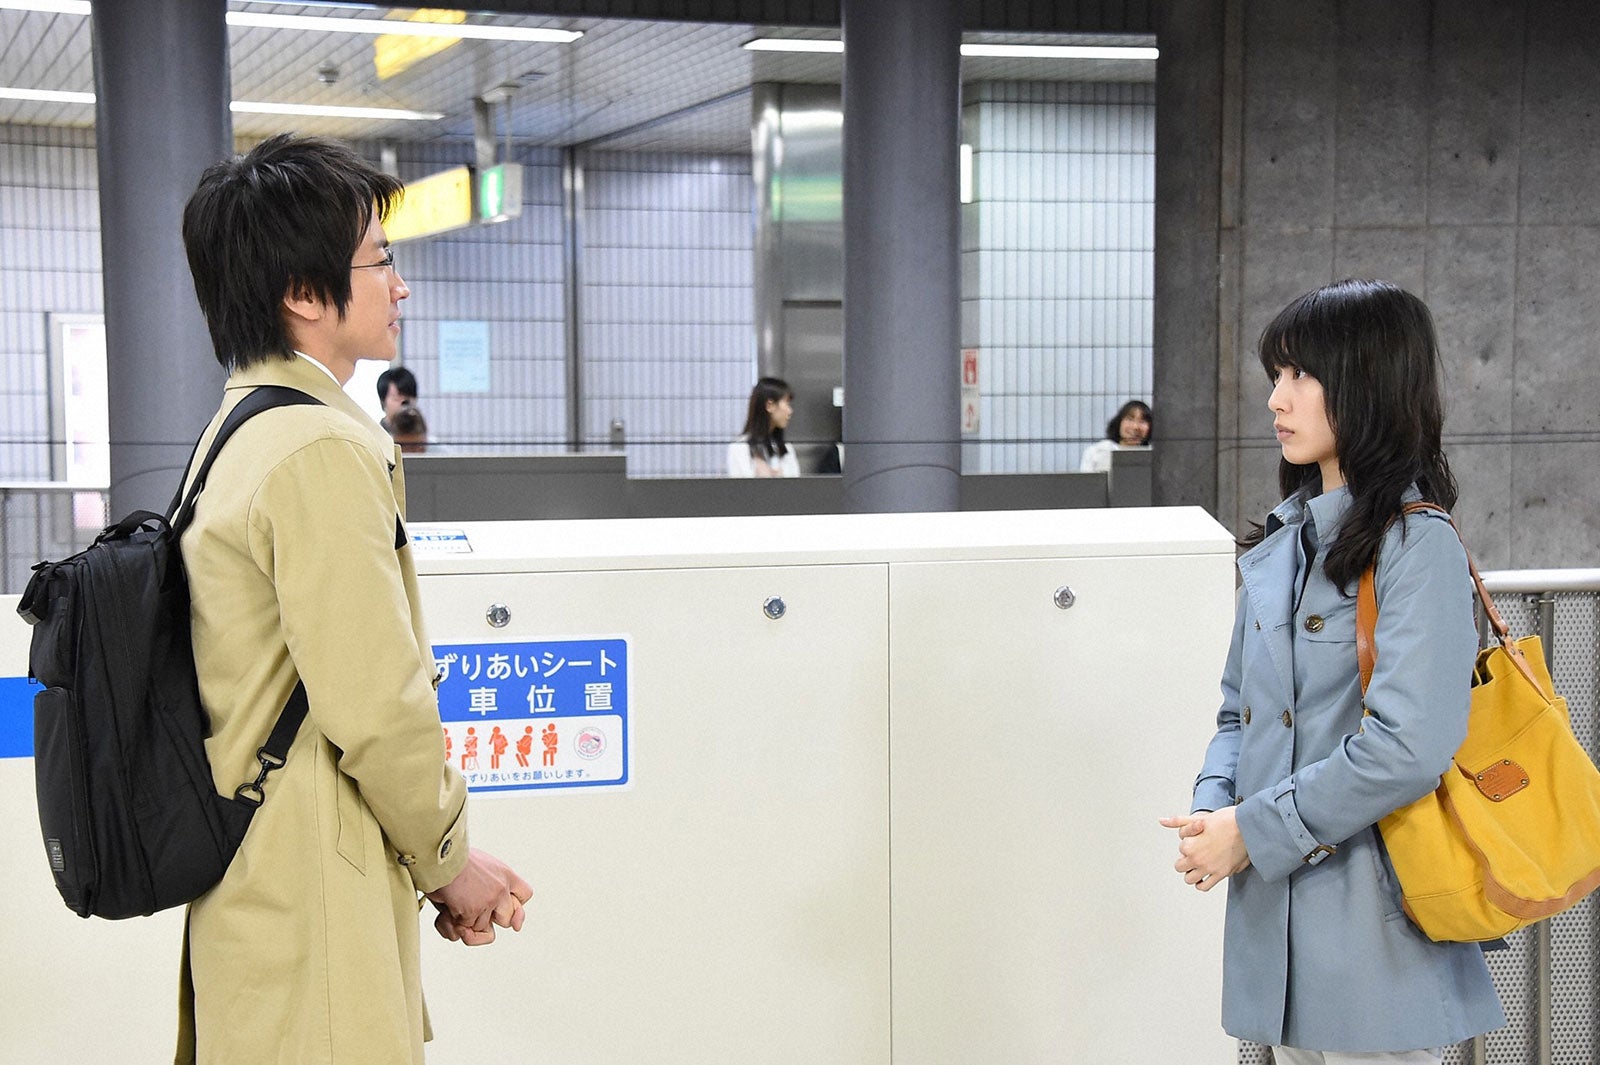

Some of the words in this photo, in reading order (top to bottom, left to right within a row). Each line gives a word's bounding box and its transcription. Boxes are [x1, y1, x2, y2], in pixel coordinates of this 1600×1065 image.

[433, 649, 617, 683] ずりあいシート
[462, 768, 590, 783] ずりあいをお願いします。
